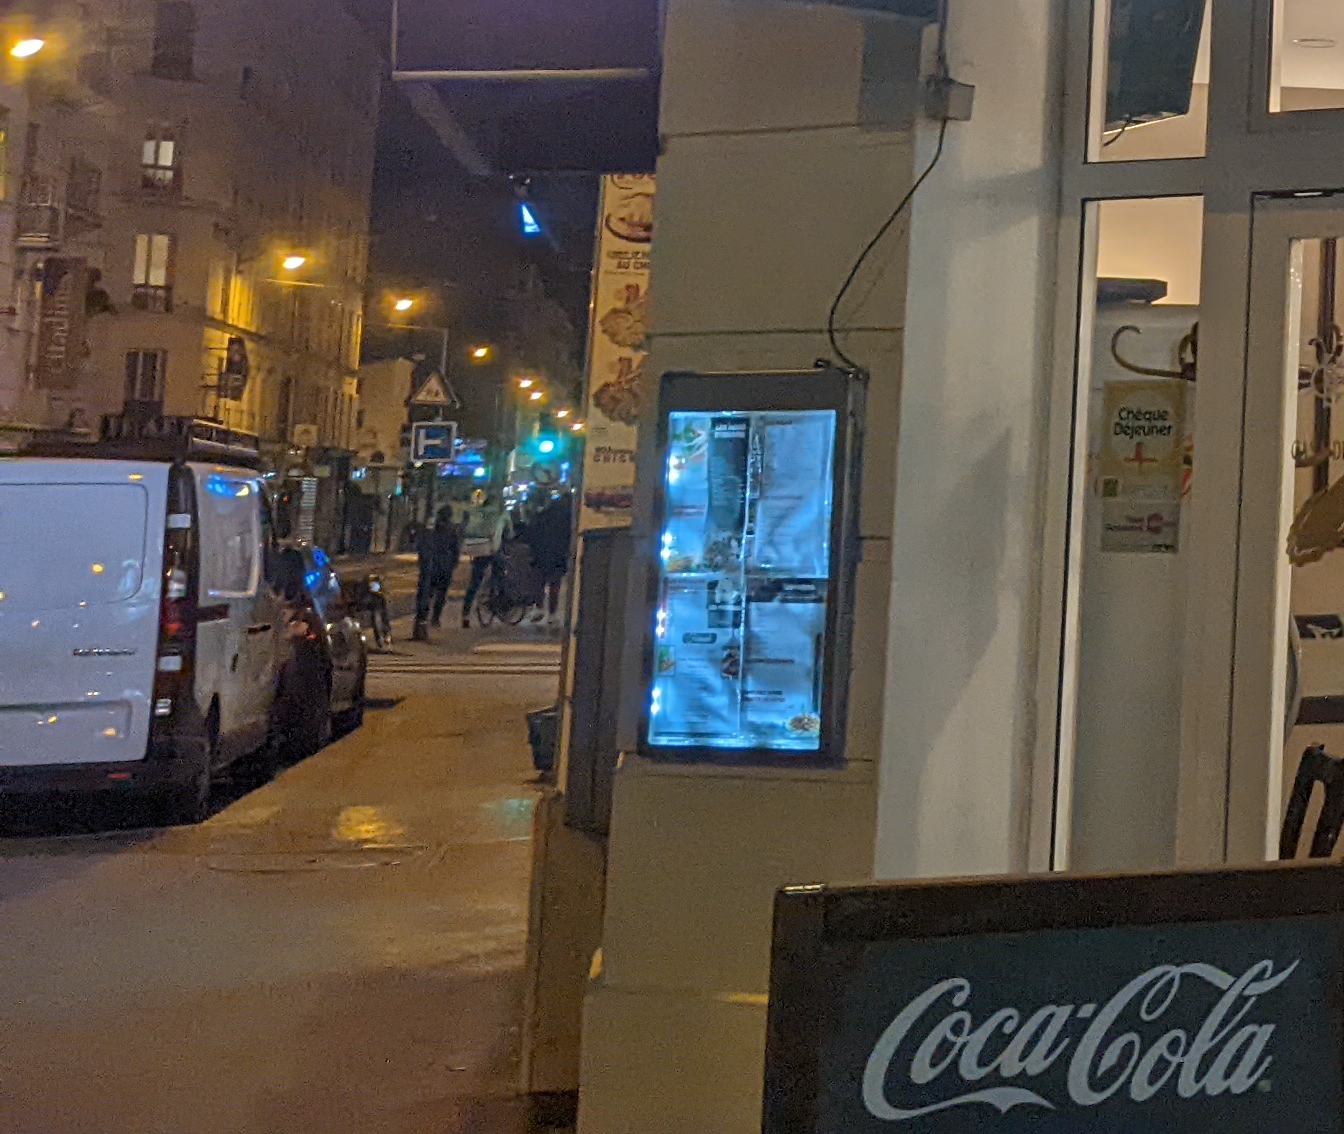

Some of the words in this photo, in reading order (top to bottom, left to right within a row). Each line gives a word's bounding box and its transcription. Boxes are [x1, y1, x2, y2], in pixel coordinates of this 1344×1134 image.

[1118, 406, 1170, 422] Chèque
[1113, 421, 1174, 439] Déjeuner
[862, 958, 1300, 1121] Coca-Cola
